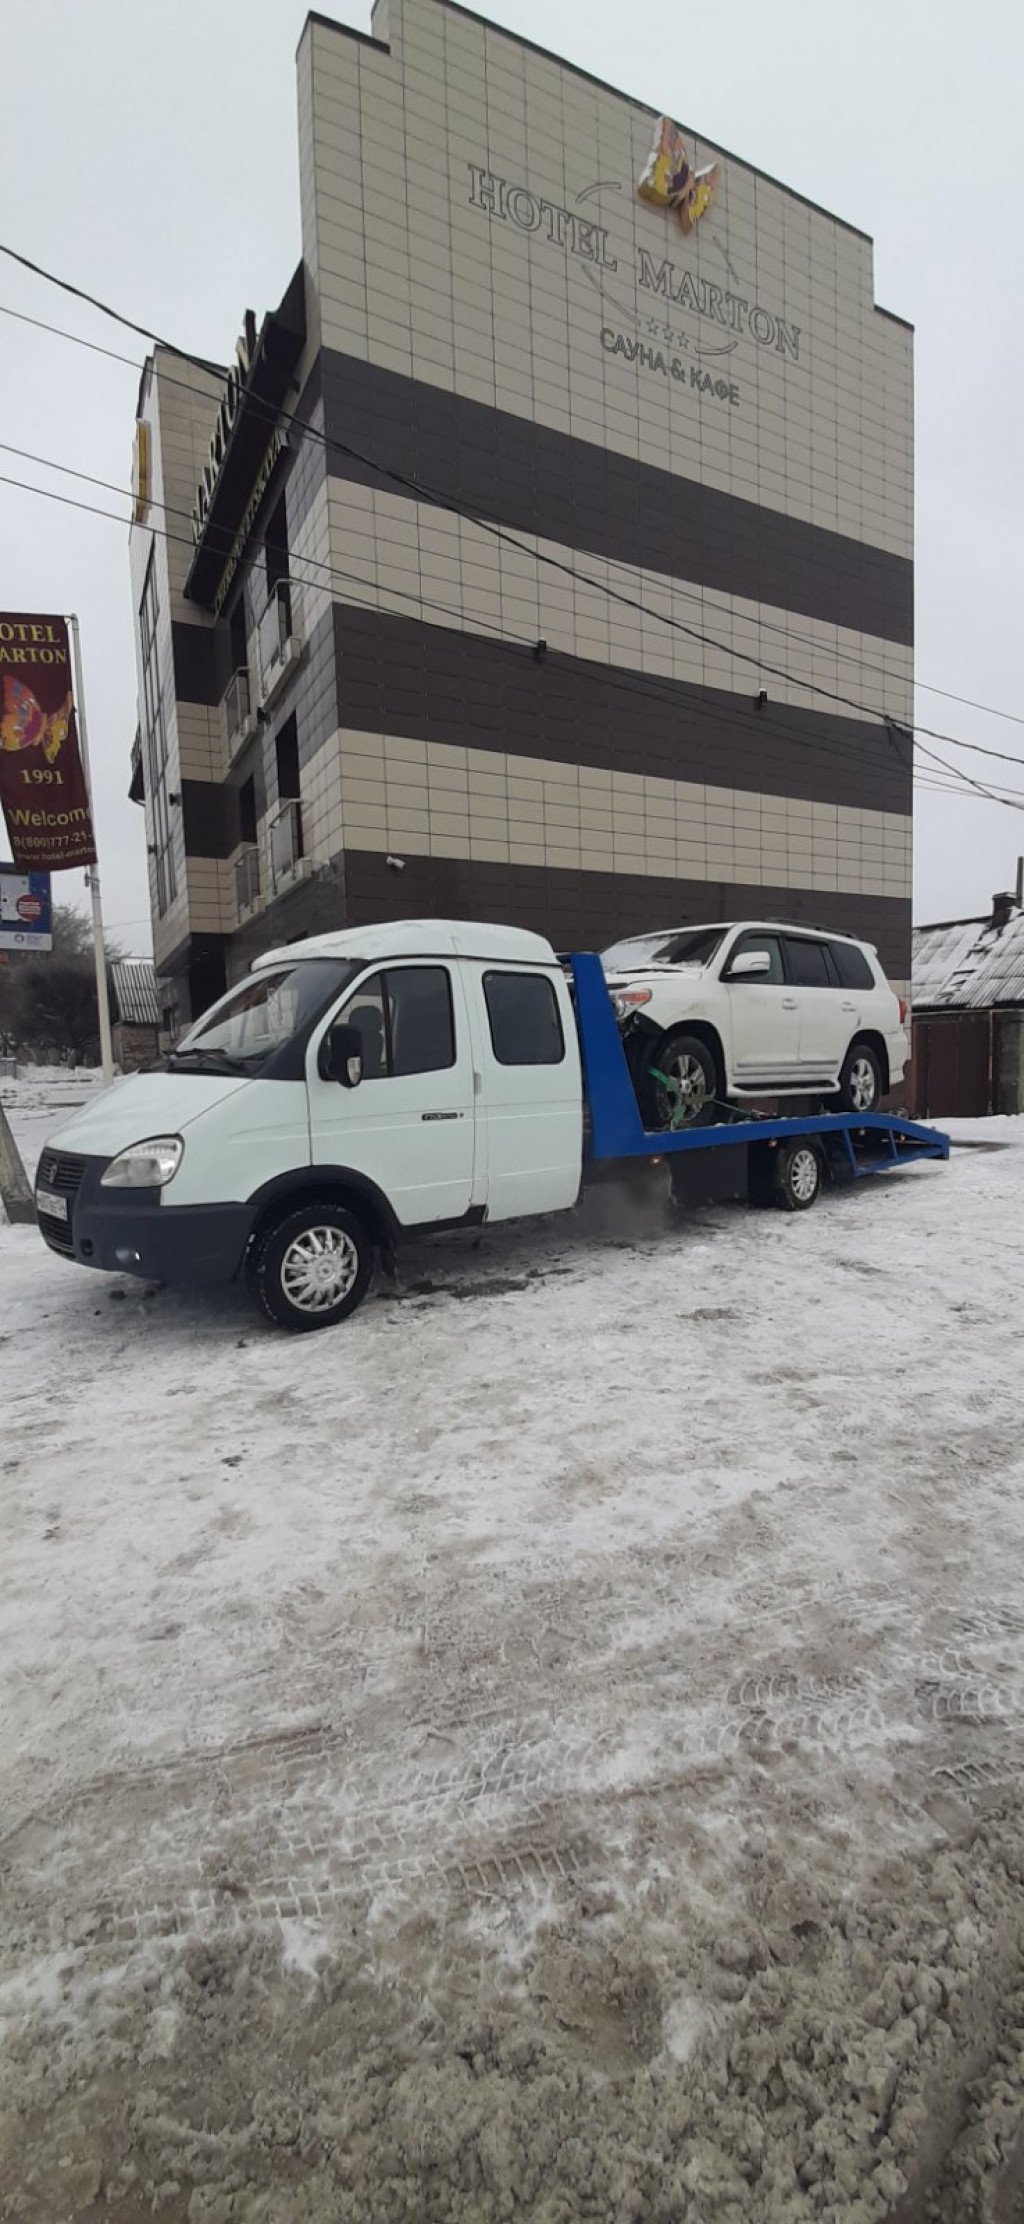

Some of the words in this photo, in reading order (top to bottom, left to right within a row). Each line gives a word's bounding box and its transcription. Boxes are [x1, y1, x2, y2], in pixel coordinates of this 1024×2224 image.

[467, 163, 618, 272] HOTEL
[637, 247, 801, 361] MARTON
[600, 327, 669, 374] САУНА
[670, 358, 687, 384] &
[689, 366, 740, 407] КАФЕ
[0, 622, 61, 642] OTEL
[0, 647, 66, 664] ARTON
[21, 769, 65, 785] 1991
